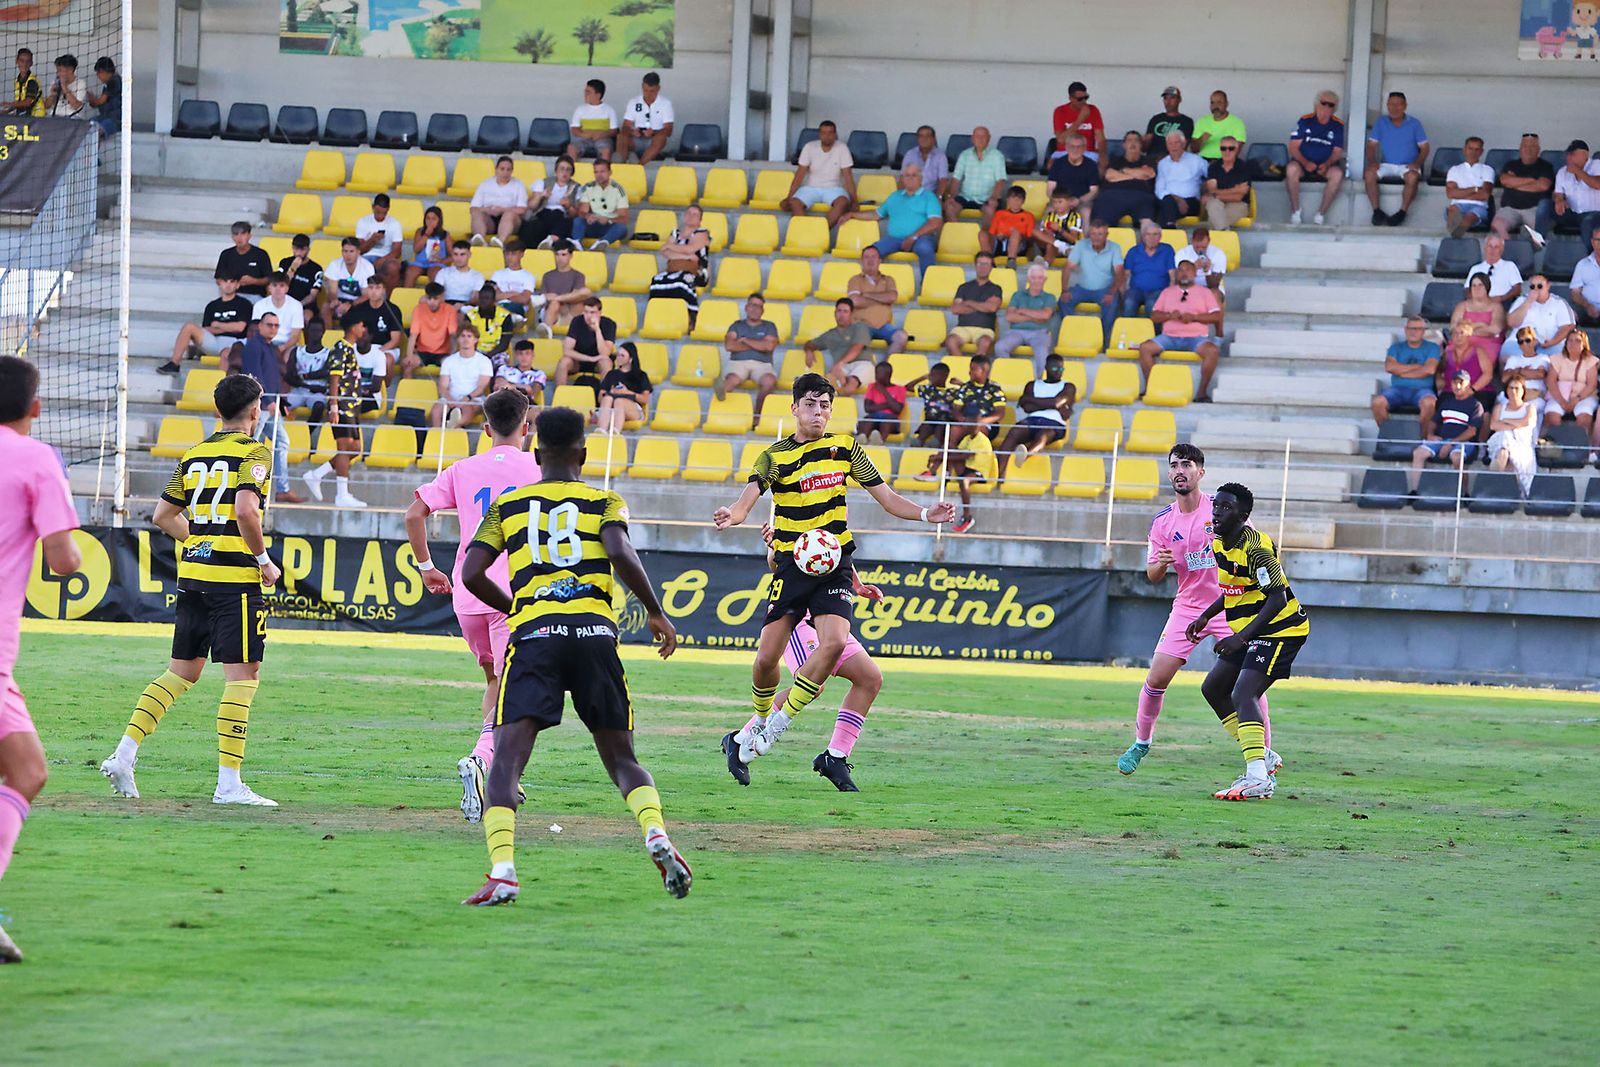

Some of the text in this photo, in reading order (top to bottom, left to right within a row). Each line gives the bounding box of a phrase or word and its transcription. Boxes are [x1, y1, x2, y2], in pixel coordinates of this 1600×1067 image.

[635, 103, 643, 112] 8
[4, 125, 40, 141] S.L.
[187, 461, 230, 524] 22
[811, 473, 843, 490] jamón
[474, 486, 517, 517] 1
[527, 500, 583, 567] 18
[138, 530, 424, 607] LPLAS
[859, 565, 900, 585] ador
[929, 568, 1000, 592] Carbón
[1219, 584, 1243, 595] món
[716, 572, 1056, 640] nguinho
[256, 610, 267, 635] 2
[551, 624, 616, 639] LAS PALMER
[881, 644, 942, 657] HUELVA
